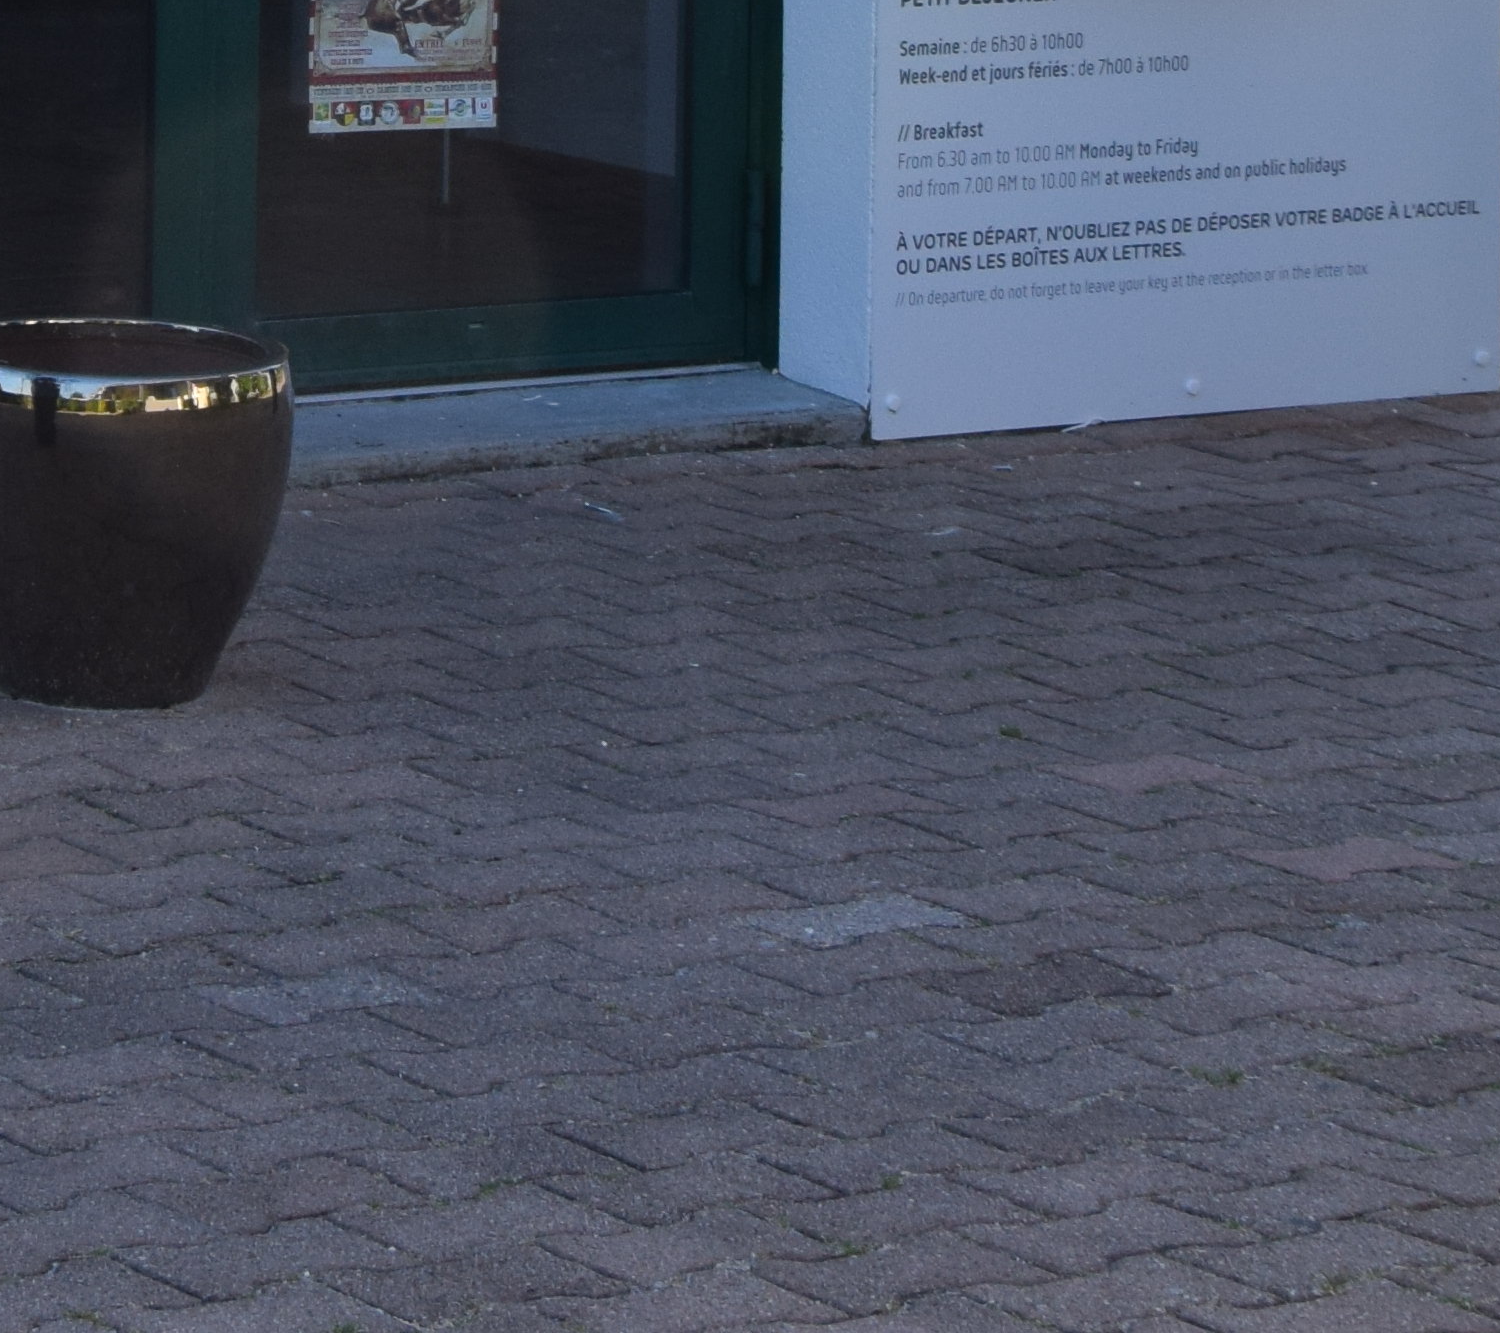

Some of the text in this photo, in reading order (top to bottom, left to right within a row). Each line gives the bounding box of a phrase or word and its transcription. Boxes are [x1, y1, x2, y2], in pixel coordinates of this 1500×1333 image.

[899, 31, 1083, 57] Semaine de 6h30 à 10h00
[899, 54, 1188, 85] Week-end et jours fériés de 7h00 à 10h00
[913, 120, 983, 140] Breakfast
[898, 137, 1199, 170] From 6.30 am to 10.00 AM Monday to Friday
[898, 156, 1347, 198] and from 7.00 AM to 10.00 AM at weekends and on public holidays
[896, 199, 1479, 251] À VOTRE DÉPART, N'OUBLIEZ PAS DE DÉPOSER VOTRE BADGE À L'ACCUEIL
[896, 241, 1185, 275] OU DANS LES BOÎTES AUX LETTRES.
